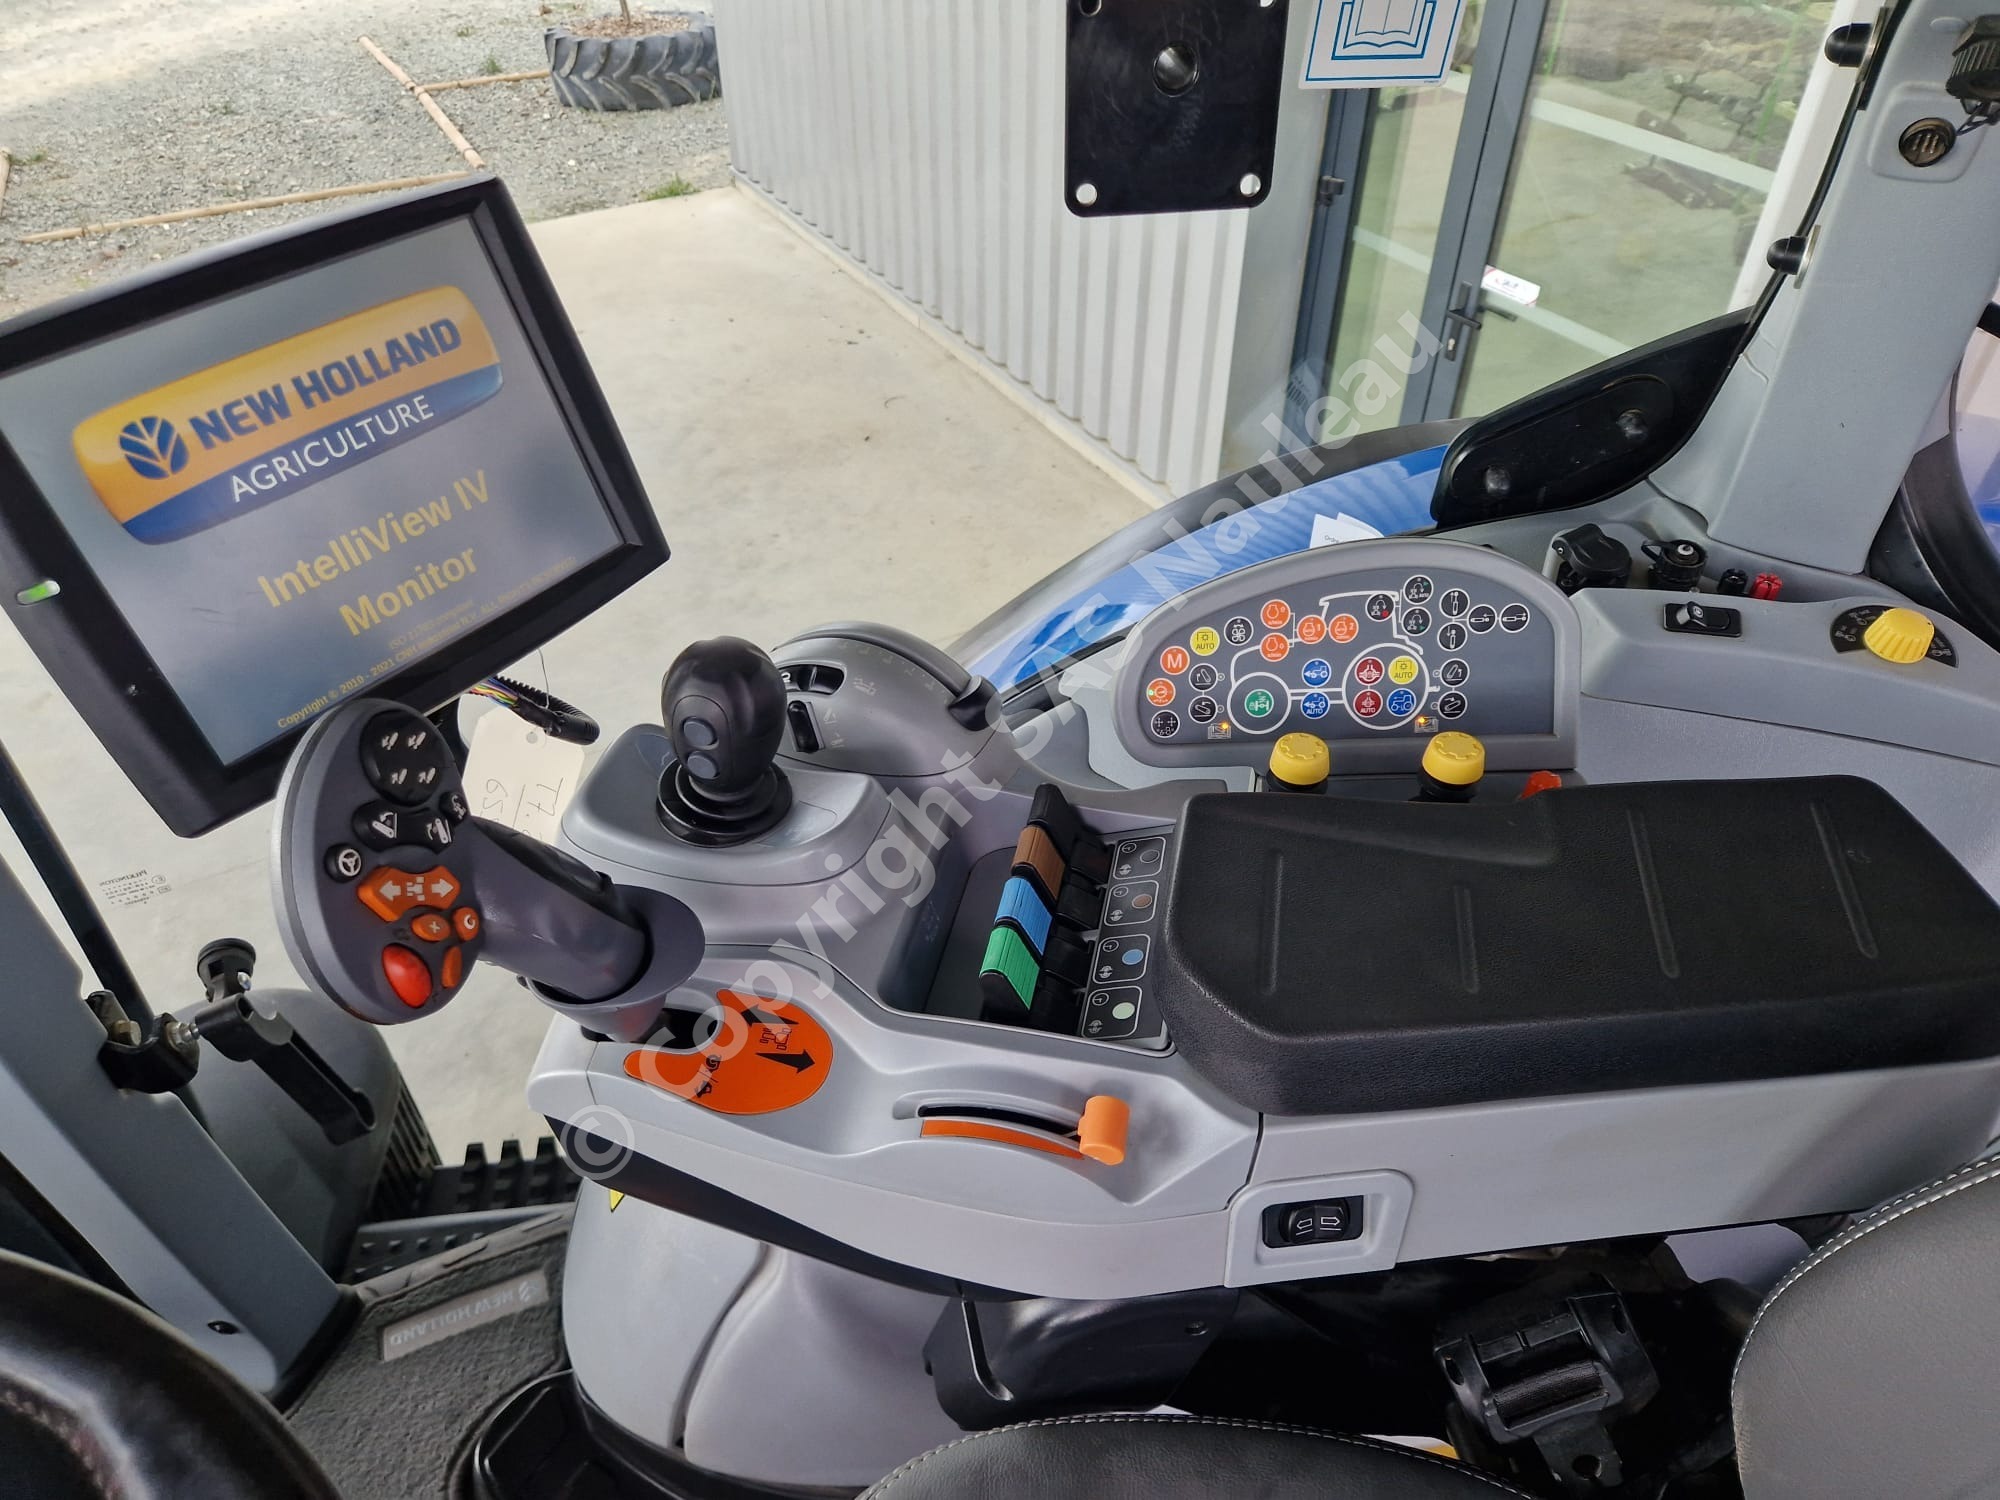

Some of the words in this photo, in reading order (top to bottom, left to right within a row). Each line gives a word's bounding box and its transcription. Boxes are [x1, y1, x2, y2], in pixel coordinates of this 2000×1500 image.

[189, 386, 291, 452] NEW
[293, 317, 463, 411] HOLLAND
[231, 395, 434, 503] AGRICULTURE
[257, 490, 455, 608] IntelliView
[455, 470, 491, 514] IV
[339, 547, 478, 637] Monitor
[1167, 654, 1182, 669] M
[278, 693, 328, 730] Copyright
[389, 1304, 472, 1345] HOLLAND
[475, 1289, 515, 1315] NEW
